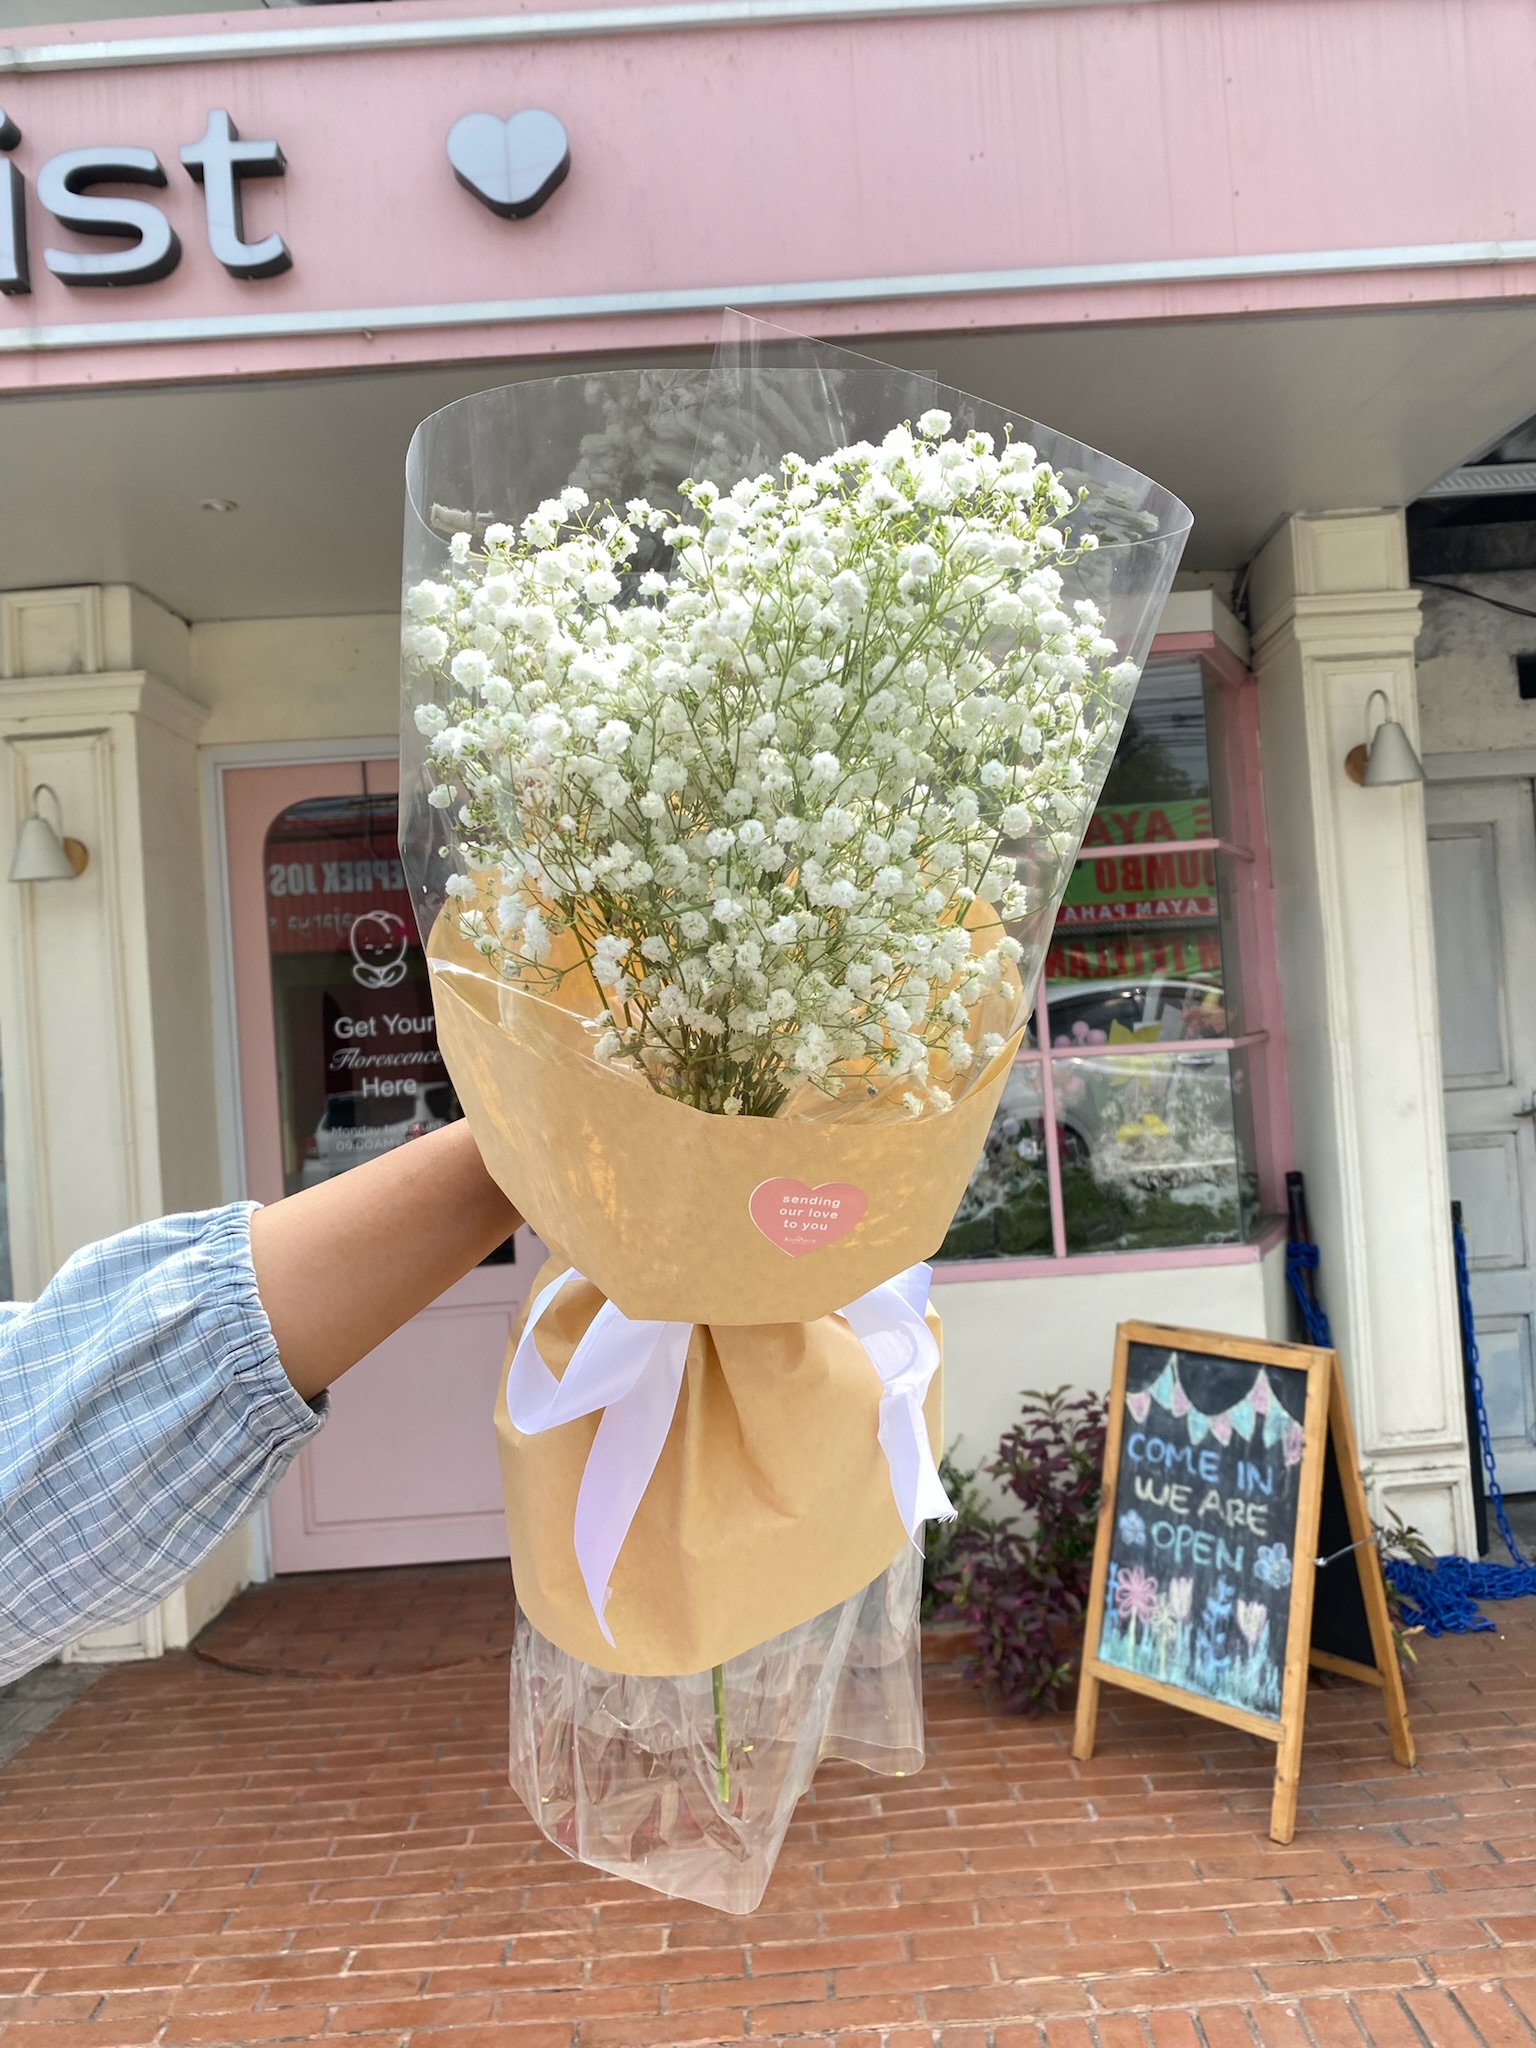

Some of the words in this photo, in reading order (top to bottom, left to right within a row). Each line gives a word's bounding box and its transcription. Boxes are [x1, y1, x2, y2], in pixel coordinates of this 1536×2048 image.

[334, 1016, 377, 1040] Get
[383, 1013, 434, 1036] Your
[362, 1076, 417, 1098] Here
[331, 1124, 380, 1137] Monday
[782, 1195, 841, 1209] sending
[779, 1208, 804, 1217] our
[808, 1208, 839, 1219] love
[783, 1218, 798, 1229] to
[801, 1220, 828, 1231] you
[1127, 1432, 1221, 1483] COME
[1237, 1460, 1273, 1496] IN
[1134, 1475, 1193, 1515] WE
[1197, 1489, 1268, 1537] ARE
[1151, 1520, 1245, 1573] OPEN
